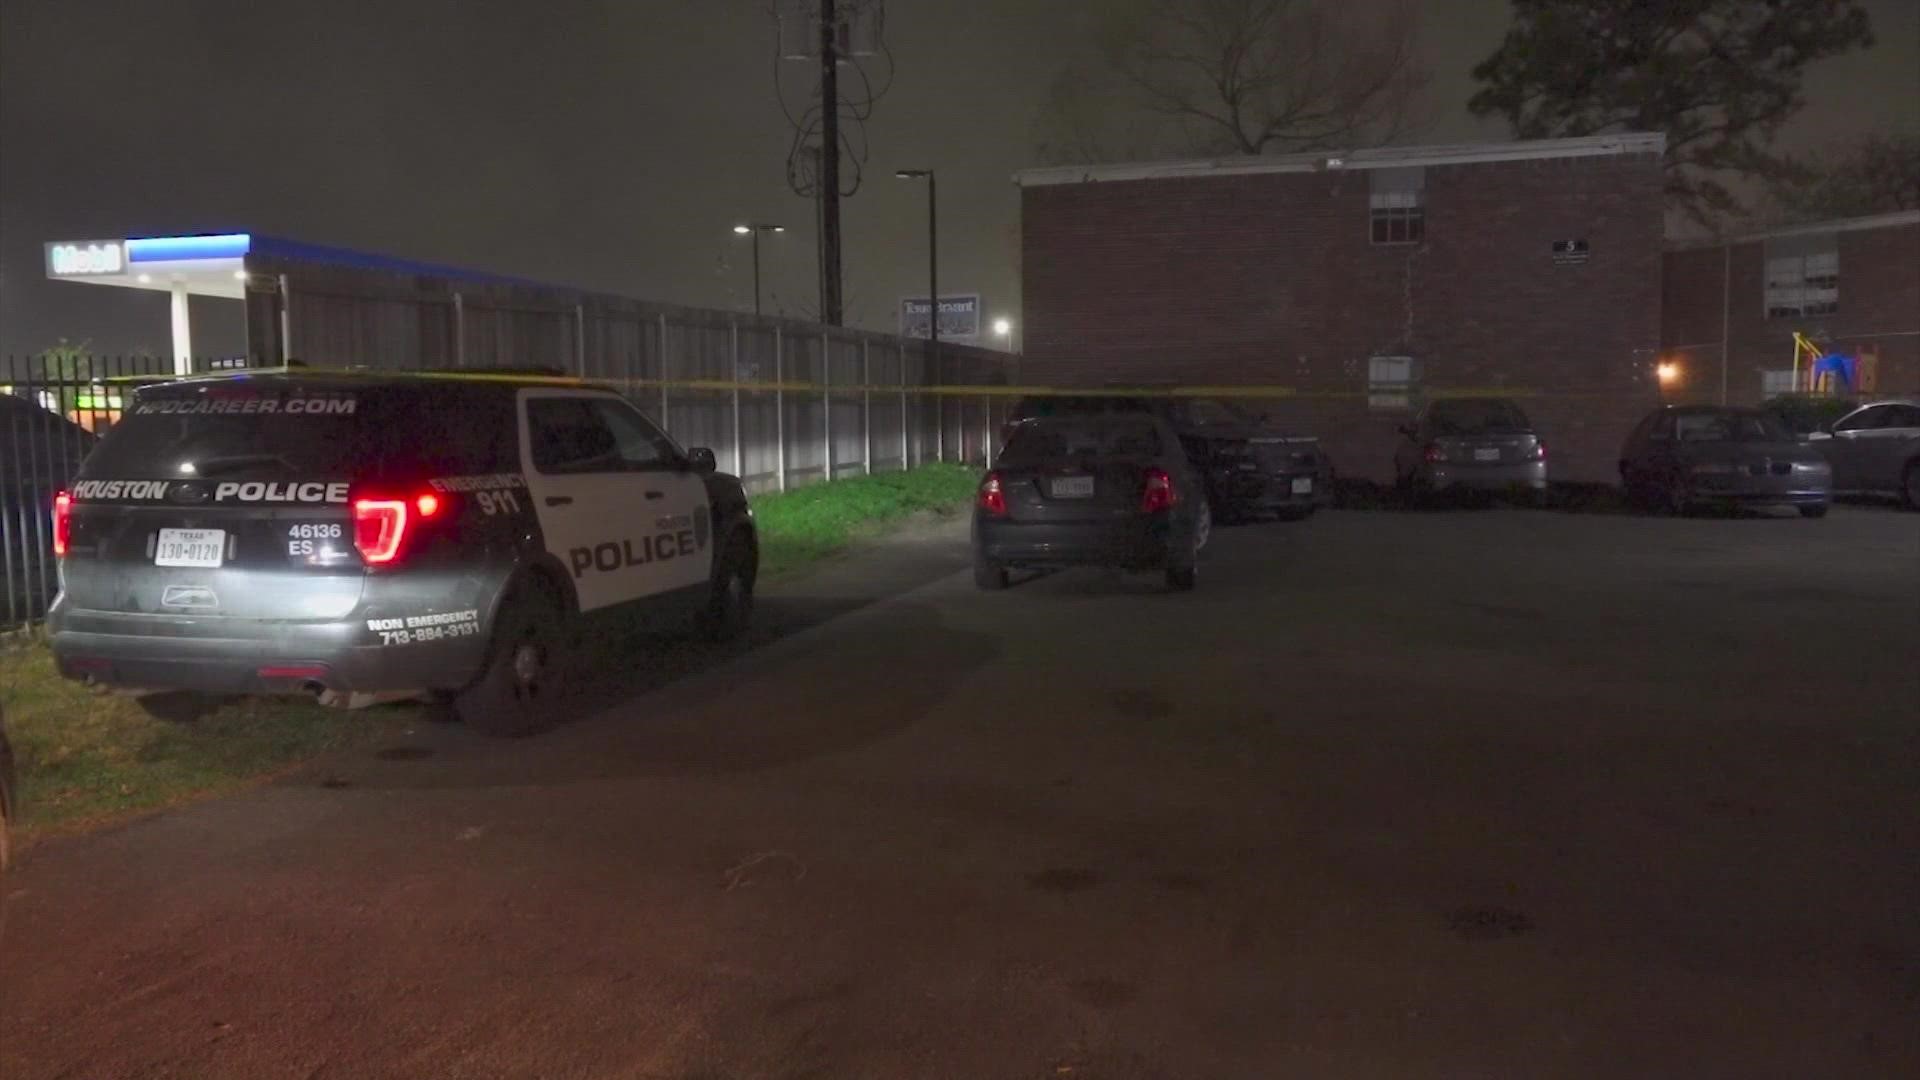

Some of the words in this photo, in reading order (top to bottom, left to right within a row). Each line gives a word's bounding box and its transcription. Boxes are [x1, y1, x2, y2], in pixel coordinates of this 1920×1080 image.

[73, 480, 170, 500] HOUSTON
[214, 482, 350, 503] POLICE
[476, 489, 520, 516] 911
[179, 532, 204, 540] TEXAS
[288, 523, 342, 539] 46136
[288, 540, 314, 556] ES
[569, 529, 696, 578] POLICE
[366, 618, 404, 631] NON
[405, 609, 478, 628] EMERGENCY
[378, 620, 480, 646] 713-884-3131
